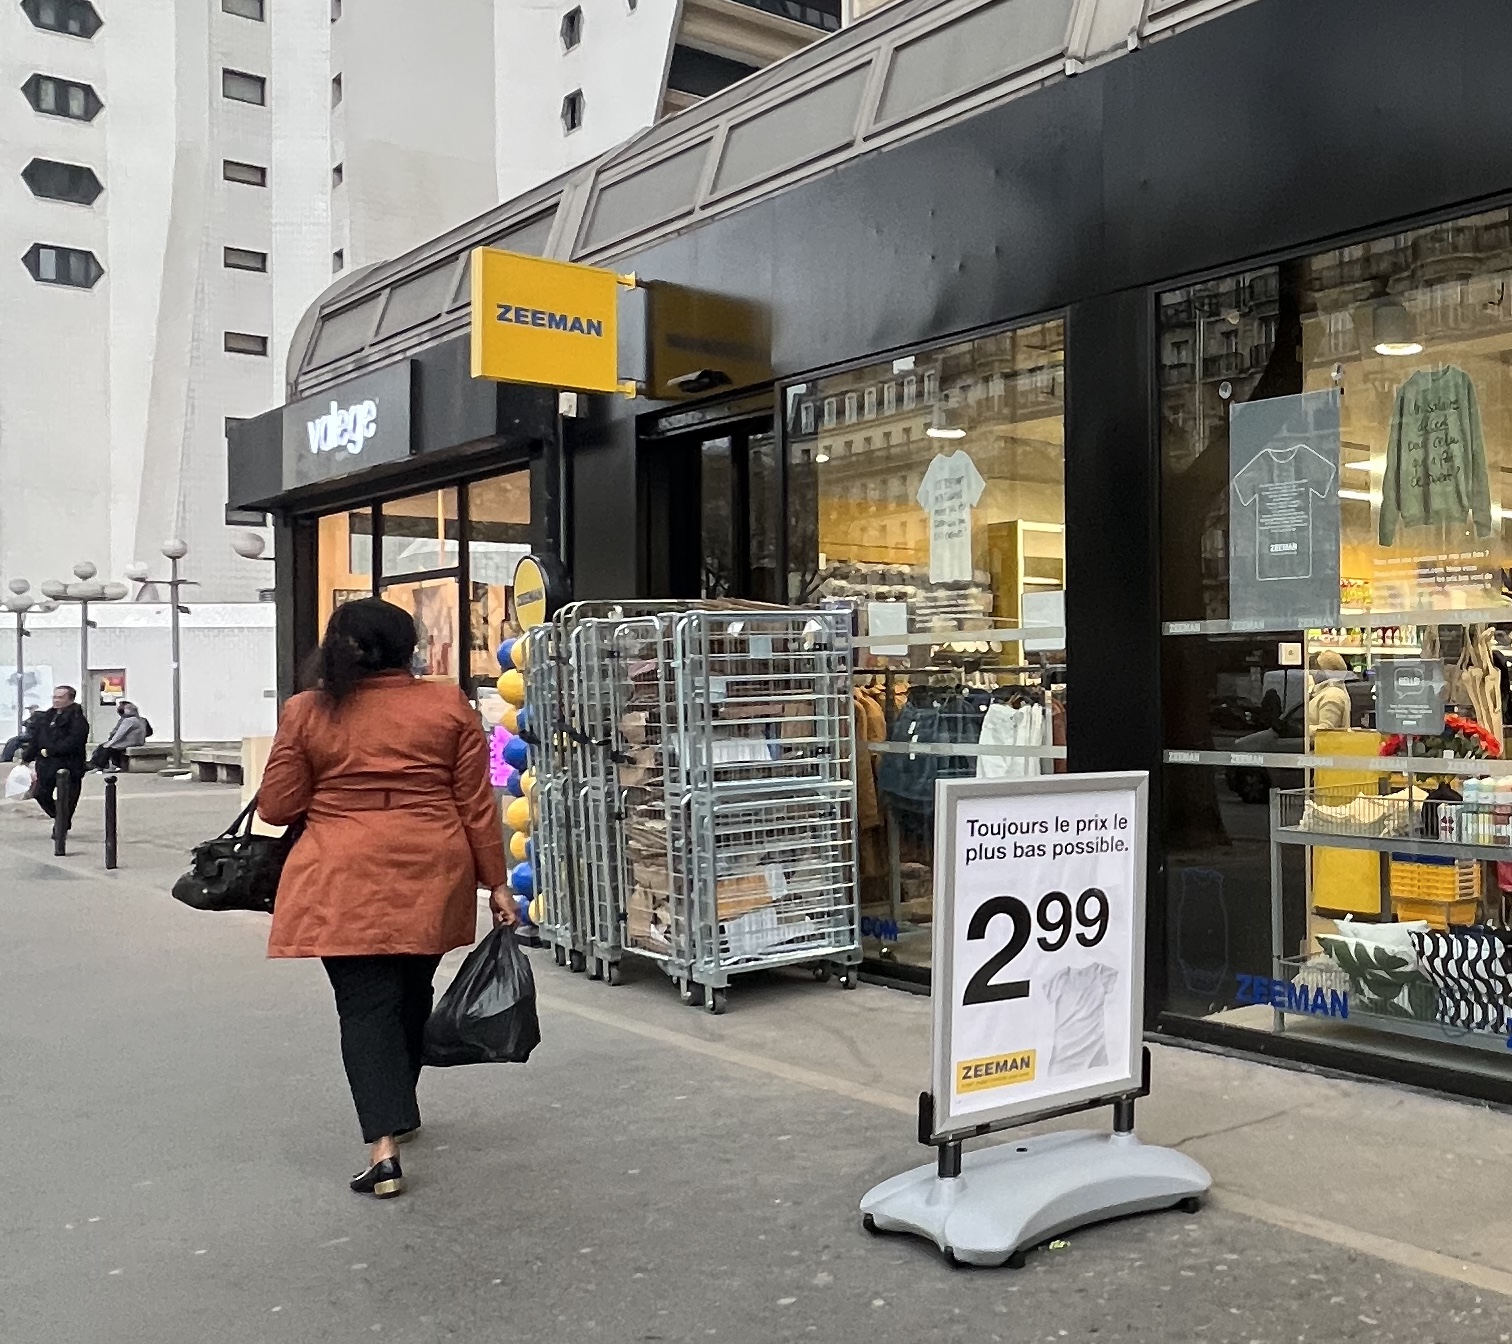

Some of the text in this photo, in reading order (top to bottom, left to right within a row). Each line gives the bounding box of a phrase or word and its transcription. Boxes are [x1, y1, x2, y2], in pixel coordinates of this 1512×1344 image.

[496, 302, 603, 338] ZEEMAN
[966, 813, 1128, 840] Toujours le prix le
[965, 836, 1130, 866] plus bas possible.
[1235, 973, 1349, 1020] ZEEMAN
[961, 1055, 1031, 1081] ZEEMAN
